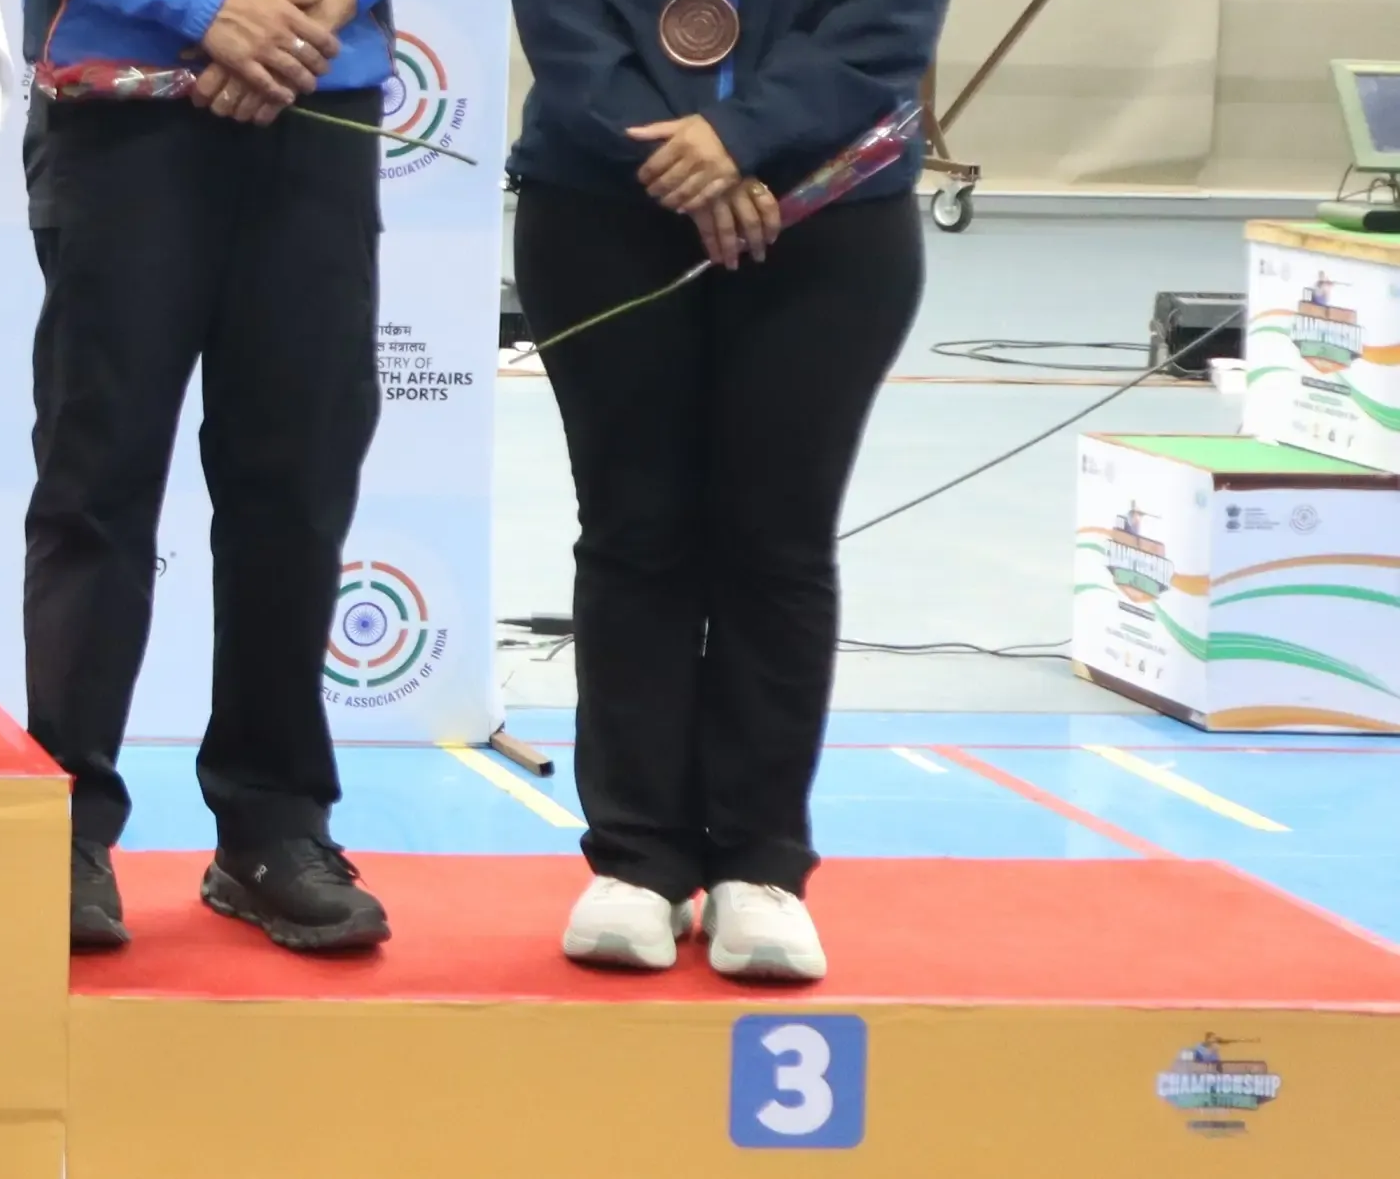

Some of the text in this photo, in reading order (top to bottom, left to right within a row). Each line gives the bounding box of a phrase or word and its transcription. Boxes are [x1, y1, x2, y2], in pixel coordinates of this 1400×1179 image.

[380, 98, 468, 179] SOCIATION OF INDIA
[378, 357, 433, 369] STRY OF
[407, 372, 473, 385] AFFAIRS
[386, 388, 449, 401] SPORTS
[345, 678, 420, 708] ASSOCIATION
[420, 663, 433, 678] OF
[430, 629, 448, 660] INDIA
[755, 1024, 833, 1135] 3
[1157, 1073, 1280, 1098] CHAMPIONSHIP
